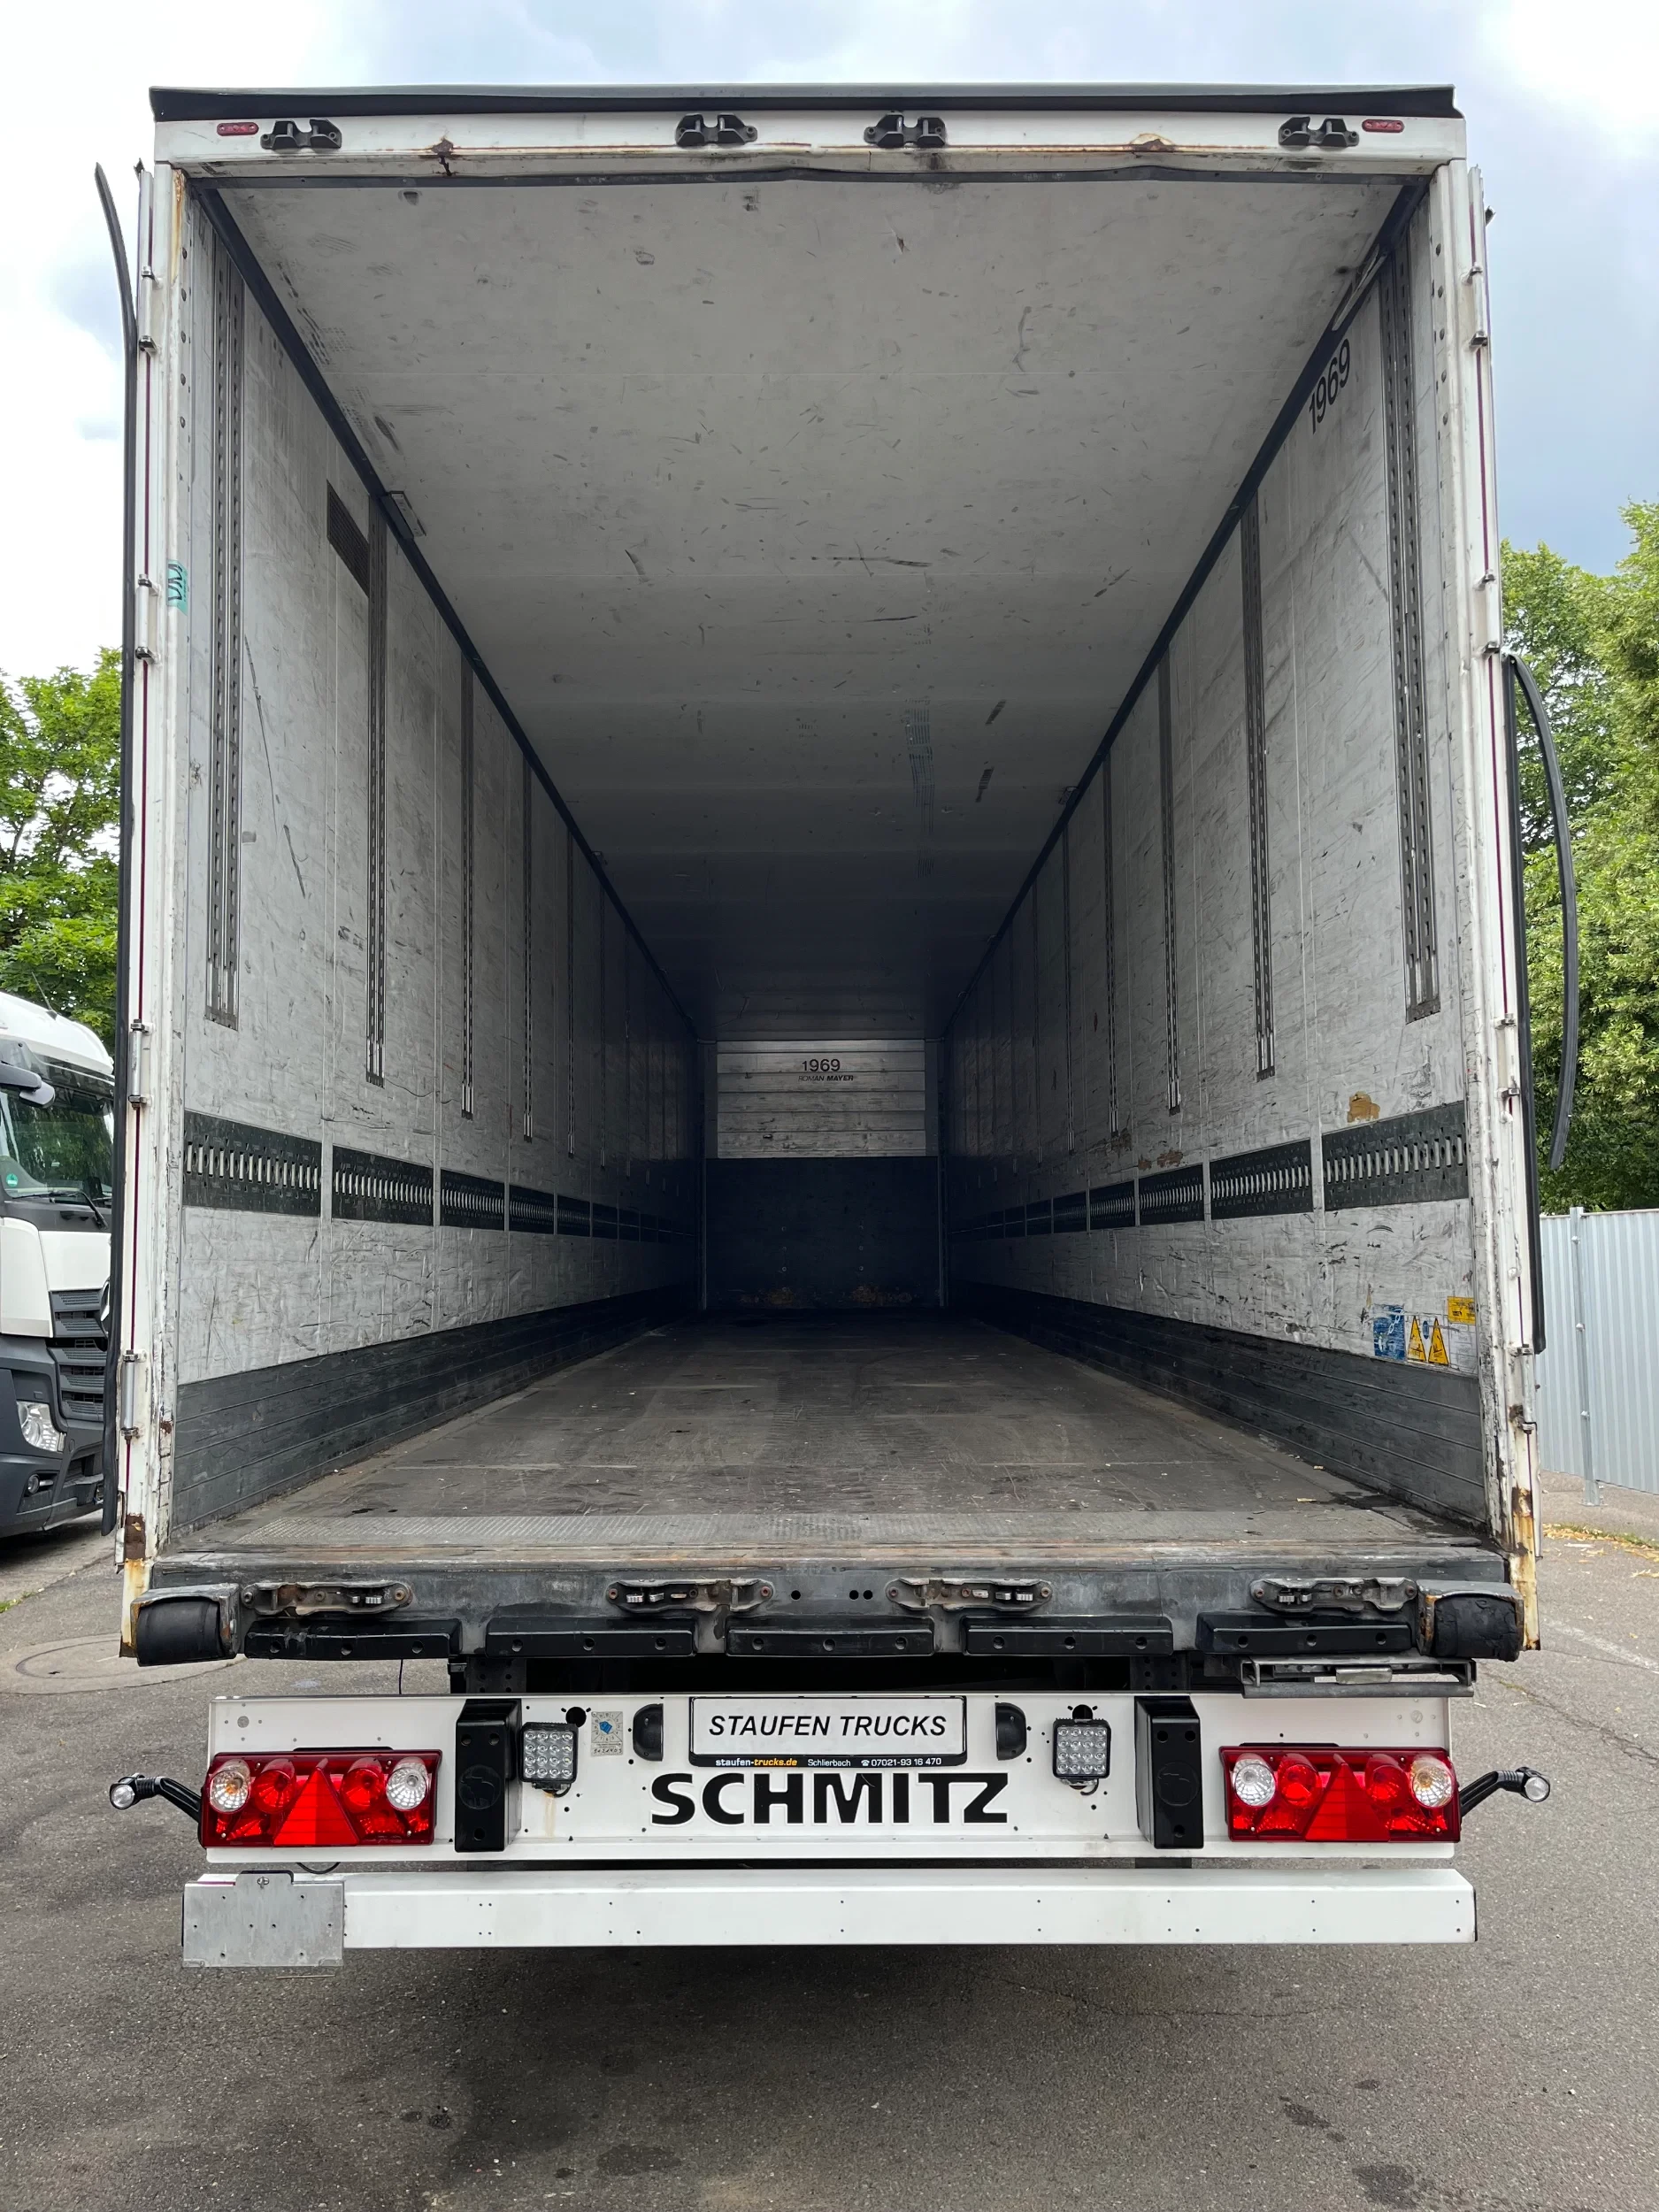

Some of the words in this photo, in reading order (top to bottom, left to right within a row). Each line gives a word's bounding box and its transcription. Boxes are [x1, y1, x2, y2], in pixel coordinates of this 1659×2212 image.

[1309, 338, 1349, 434] 1969
[802, 1058, 841, 1072] 1969
[709, 1715, 831, 1737] STAUFEN
[840, 1715, 947, 1737] TRUCKS
[715, 1757, 798, 1767] staufen-trucks.de
[807, 1758, 851, 1767] Schlierbach
[871, 1758, 912, 1767] 07021-93
[925, 1757, 942, 1766] 470
[651, 1772, 1008, 1824] SCHMITZ
